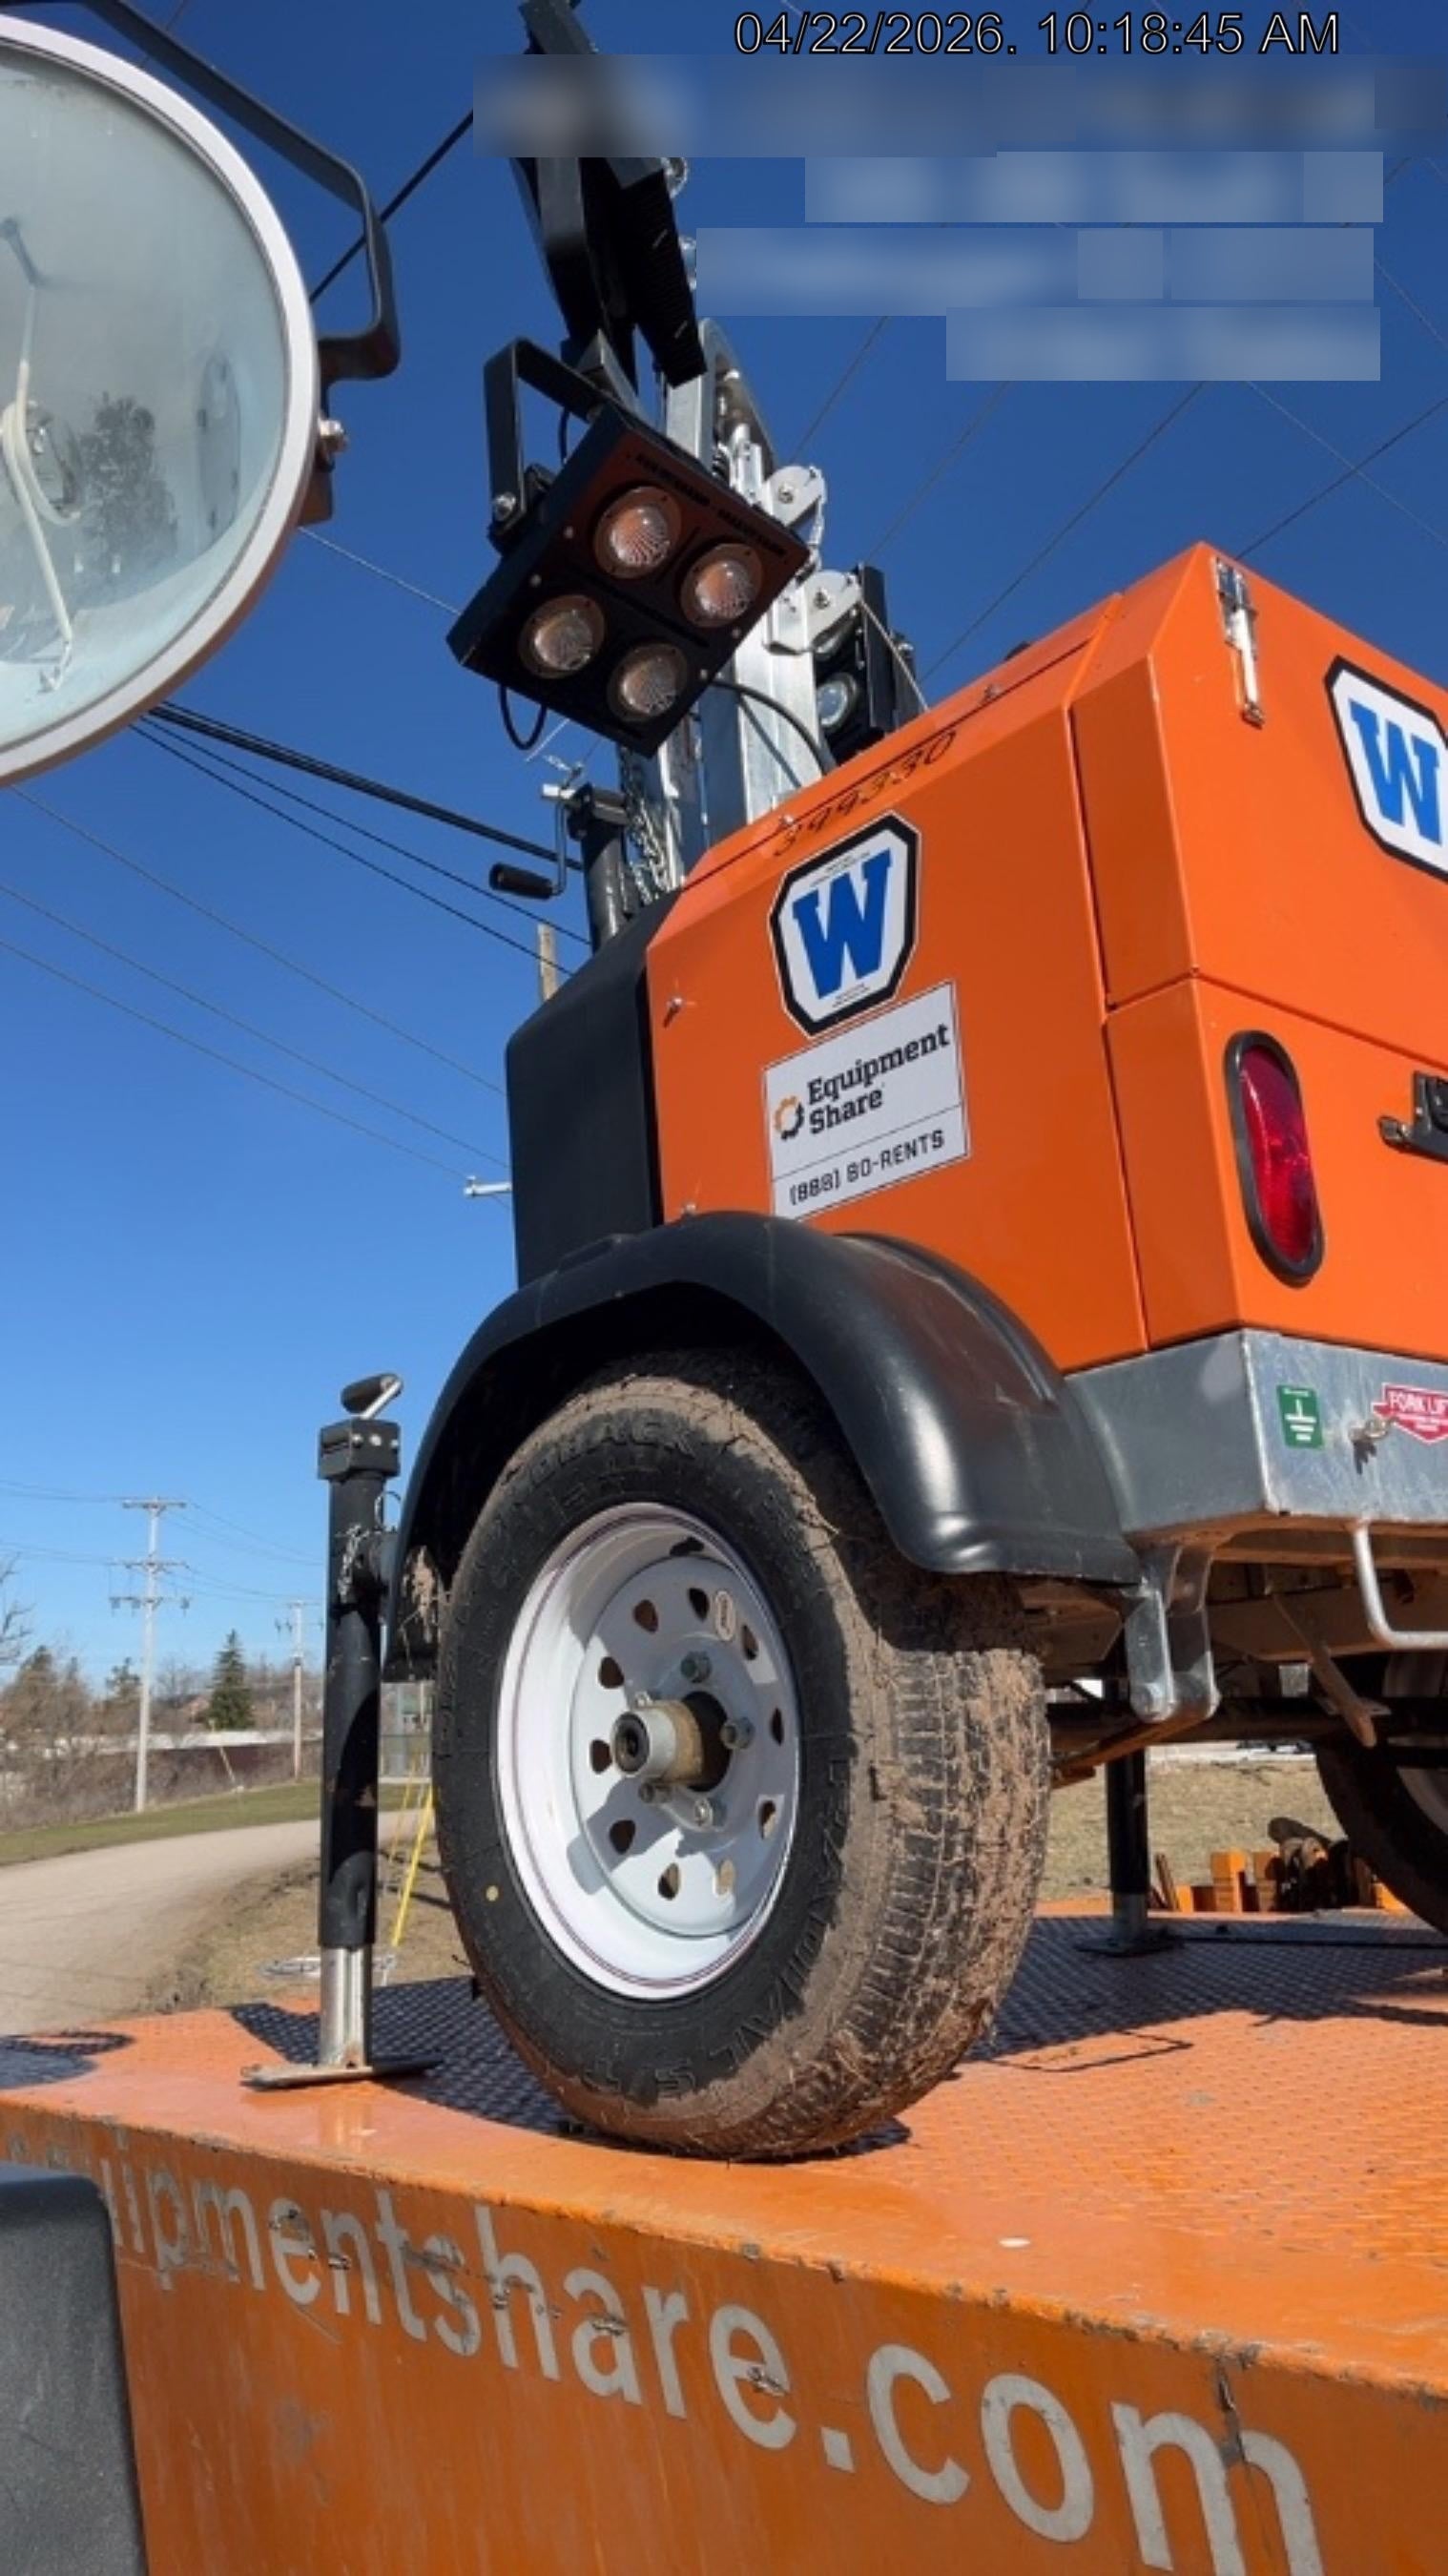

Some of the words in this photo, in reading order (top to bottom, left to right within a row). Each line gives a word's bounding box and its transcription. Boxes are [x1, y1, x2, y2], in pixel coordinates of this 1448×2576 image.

[1348, 697, 1442, 846] W
[792, 847, 893, 1000] W
[806, 1023, 950, 1105] Equipment
[809, 1088, 882, 1134] Share
[789, 1169, 840, 1206] (888)
[846, 1129, 945, 1184] 80-RENTS
